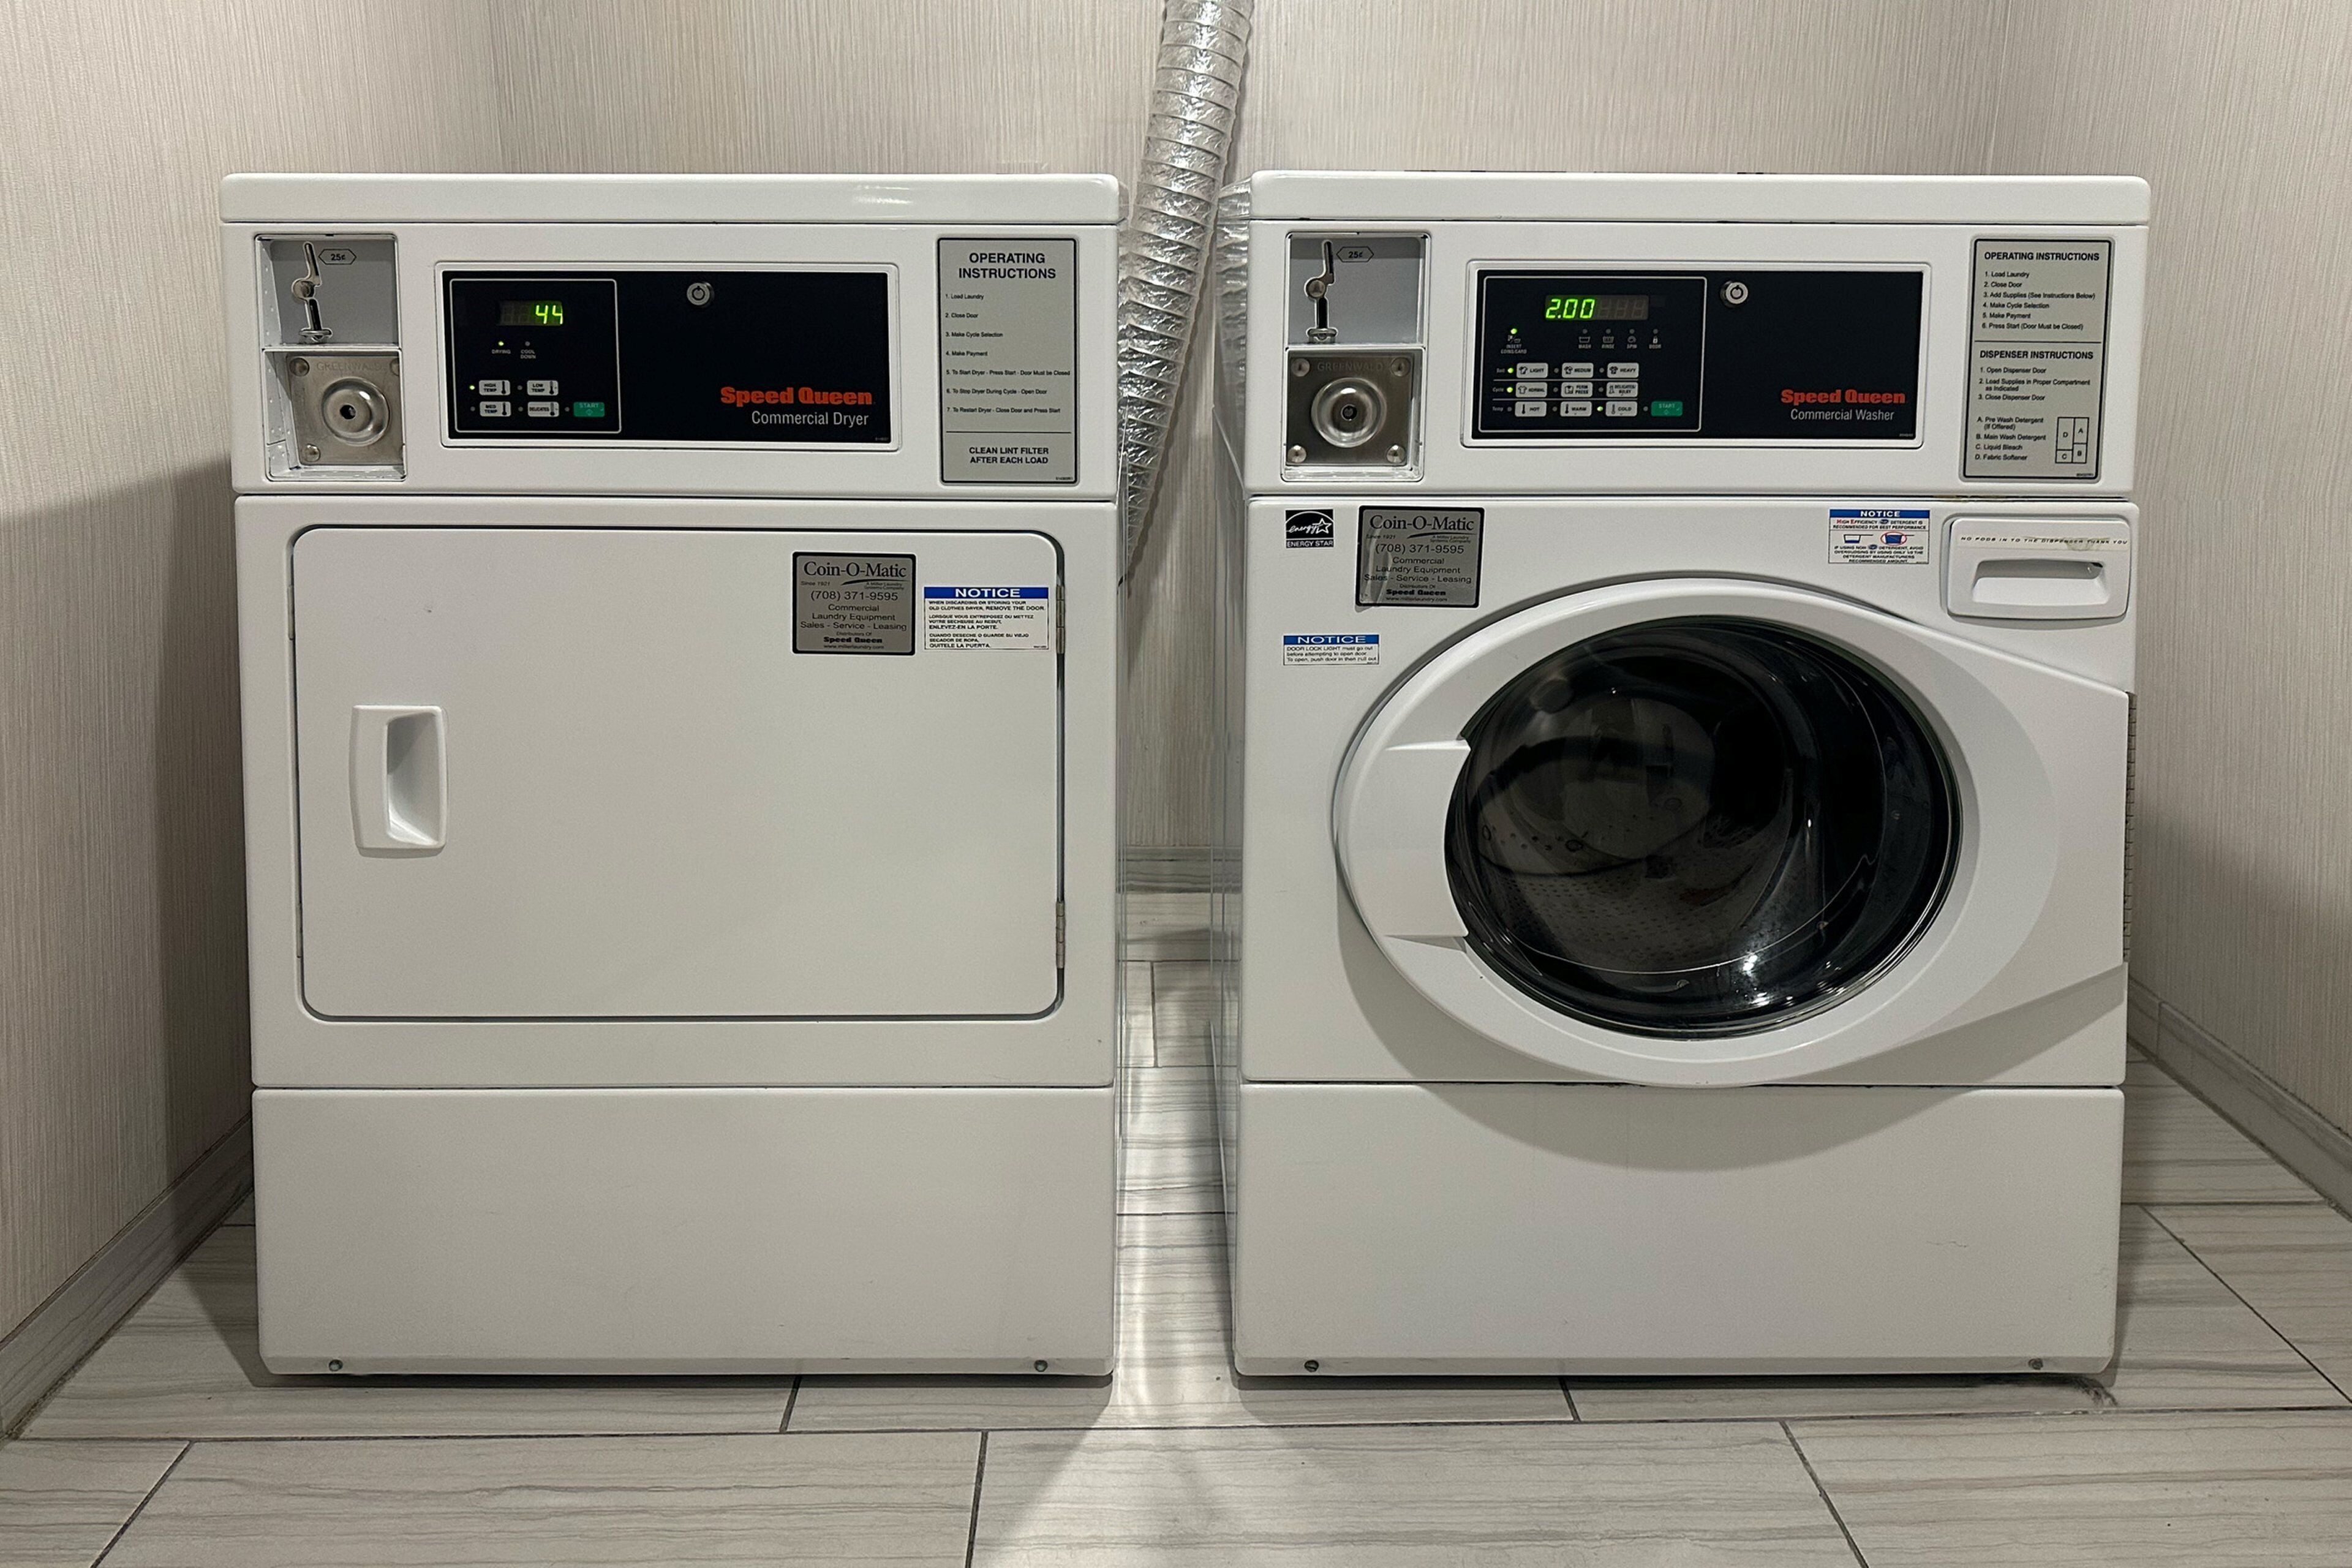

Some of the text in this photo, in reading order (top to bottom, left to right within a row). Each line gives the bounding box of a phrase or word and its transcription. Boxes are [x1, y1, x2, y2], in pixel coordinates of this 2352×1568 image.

[969, 252, 1045, 263] OPERATING
[959, 268, 1055, 279] INSTRUCTIONS
[1546, 299, 1594, 318] 2.00
[536, 306, 562, 324] 44
[2030, 351, 2094, 360] INSTRUCTIONS
[721, 386, 872, 407] Speed Queen
[1781, 390, 1905, 405] Speed Queen
[752, 411, 869, 428] Commercial Dryer
[1791, 409, 1894, 420] Commercial Washer
[1370, 515, 1474, 530] Coin-O-Matic
[1376, 544, 1464, 555] (708) 371-9595
[804, 562, 907, 577] Coin-O-Matic
[1376, 565, 1411, 575] Laundry
[811, 590, 897, 601] (708) 371-9595
[850, 613, 895, 622] Equipment
